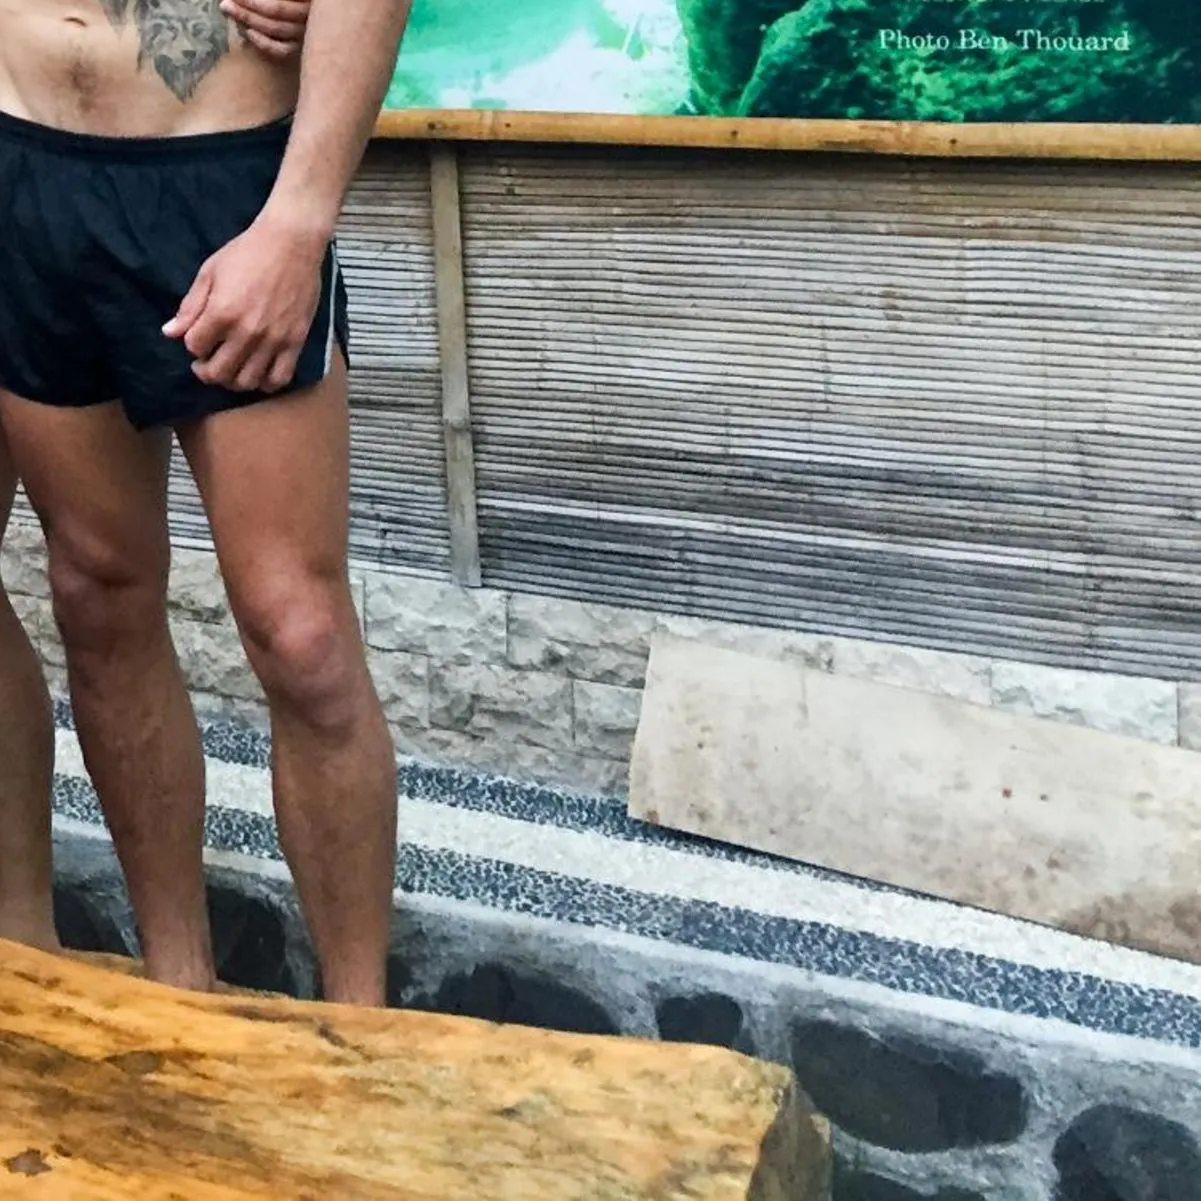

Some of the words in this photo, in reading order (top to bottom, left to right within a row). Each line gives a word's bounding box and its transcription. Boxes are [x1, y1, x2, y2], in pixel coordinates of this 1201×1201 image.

[878, 28, 950, 51] Photo
[957, 28, 1008, 51] Ben
[1015, 28, 1131, 51] Thouard
